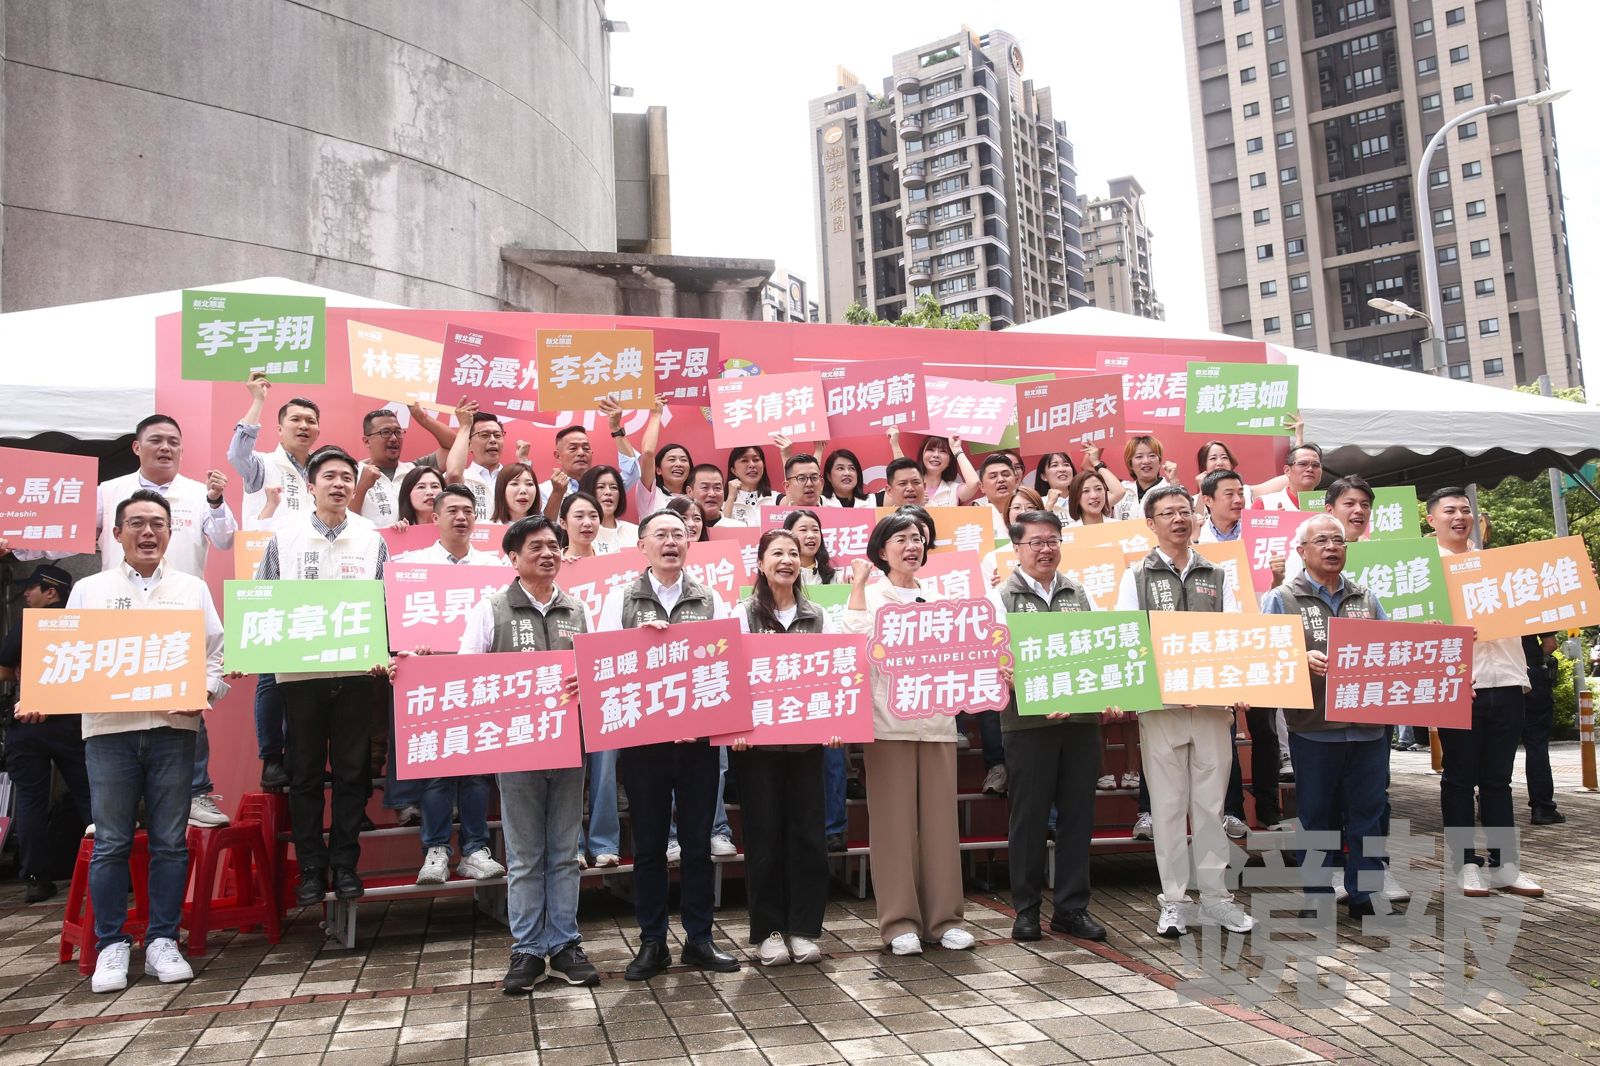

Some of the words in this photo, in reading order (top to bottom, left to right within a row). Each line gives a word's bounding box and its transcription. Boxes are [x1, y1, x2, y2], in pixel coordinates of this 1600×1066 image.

[196, 315, 314, 356] 李宇翔
[549, 347, 643, 389] 李余典
[654, 347, 709, 380] 宇恩
[723, 386, 814, 428] 李倩萍
[826, 373, 915, 417] 邱婷蔚
[1026, 393, 1118, 434] 山田摩衣
[3, 524, 78, 539] 一起贏！
[1370, 503, 1403, 532] 雄
[1253, 536, 1298, 570] 張
[1461, 556, 1582, 620] 陳俊維
[240, 601, 372, 649] 陳韋任
[881, 605, 989, 648] 新時代
[1307, 604, 1327, 642] 陳世榮
[1388, 601, 1435, 620] 起贏！
[1525, 601, 1588, 624] 一起贏！
[38, 631, 192, 685] 游明諺
[593, 651, 639, 682] 溫暖
[645, 638, 690, 670] 創新
[886, 657, 916, 667] NEW
[921, 654, 964, 664] TAIPEI
[968, 649, 999, 660] CITY
[1018, 621, 1141, 662] 市長蘇巧慧
[1161, 624, 1293, 657] 市長蘇巧慧
[1336, 637, 1463, 670] 市長蘇巧慧
[747, 645, 857, 686] 長蘇巧慧
[1024, 660, 1147, 703] 議員全壘打
[1163, 660, 1298, 693] 議員全壘打
[110, 681, 188, 701] 一起贏！
[406, 663, 563, 716] 市長蘇巧慧
[600, 661, 732, 735] 蘇巧慧
[752, 688, 861, 728] 員全壘打
[895, 668, 1002, 712] 新市長
[1334, 677, 1463, 710] 議員全壘打
[407, 709, 567, 765] 議員全壘打
